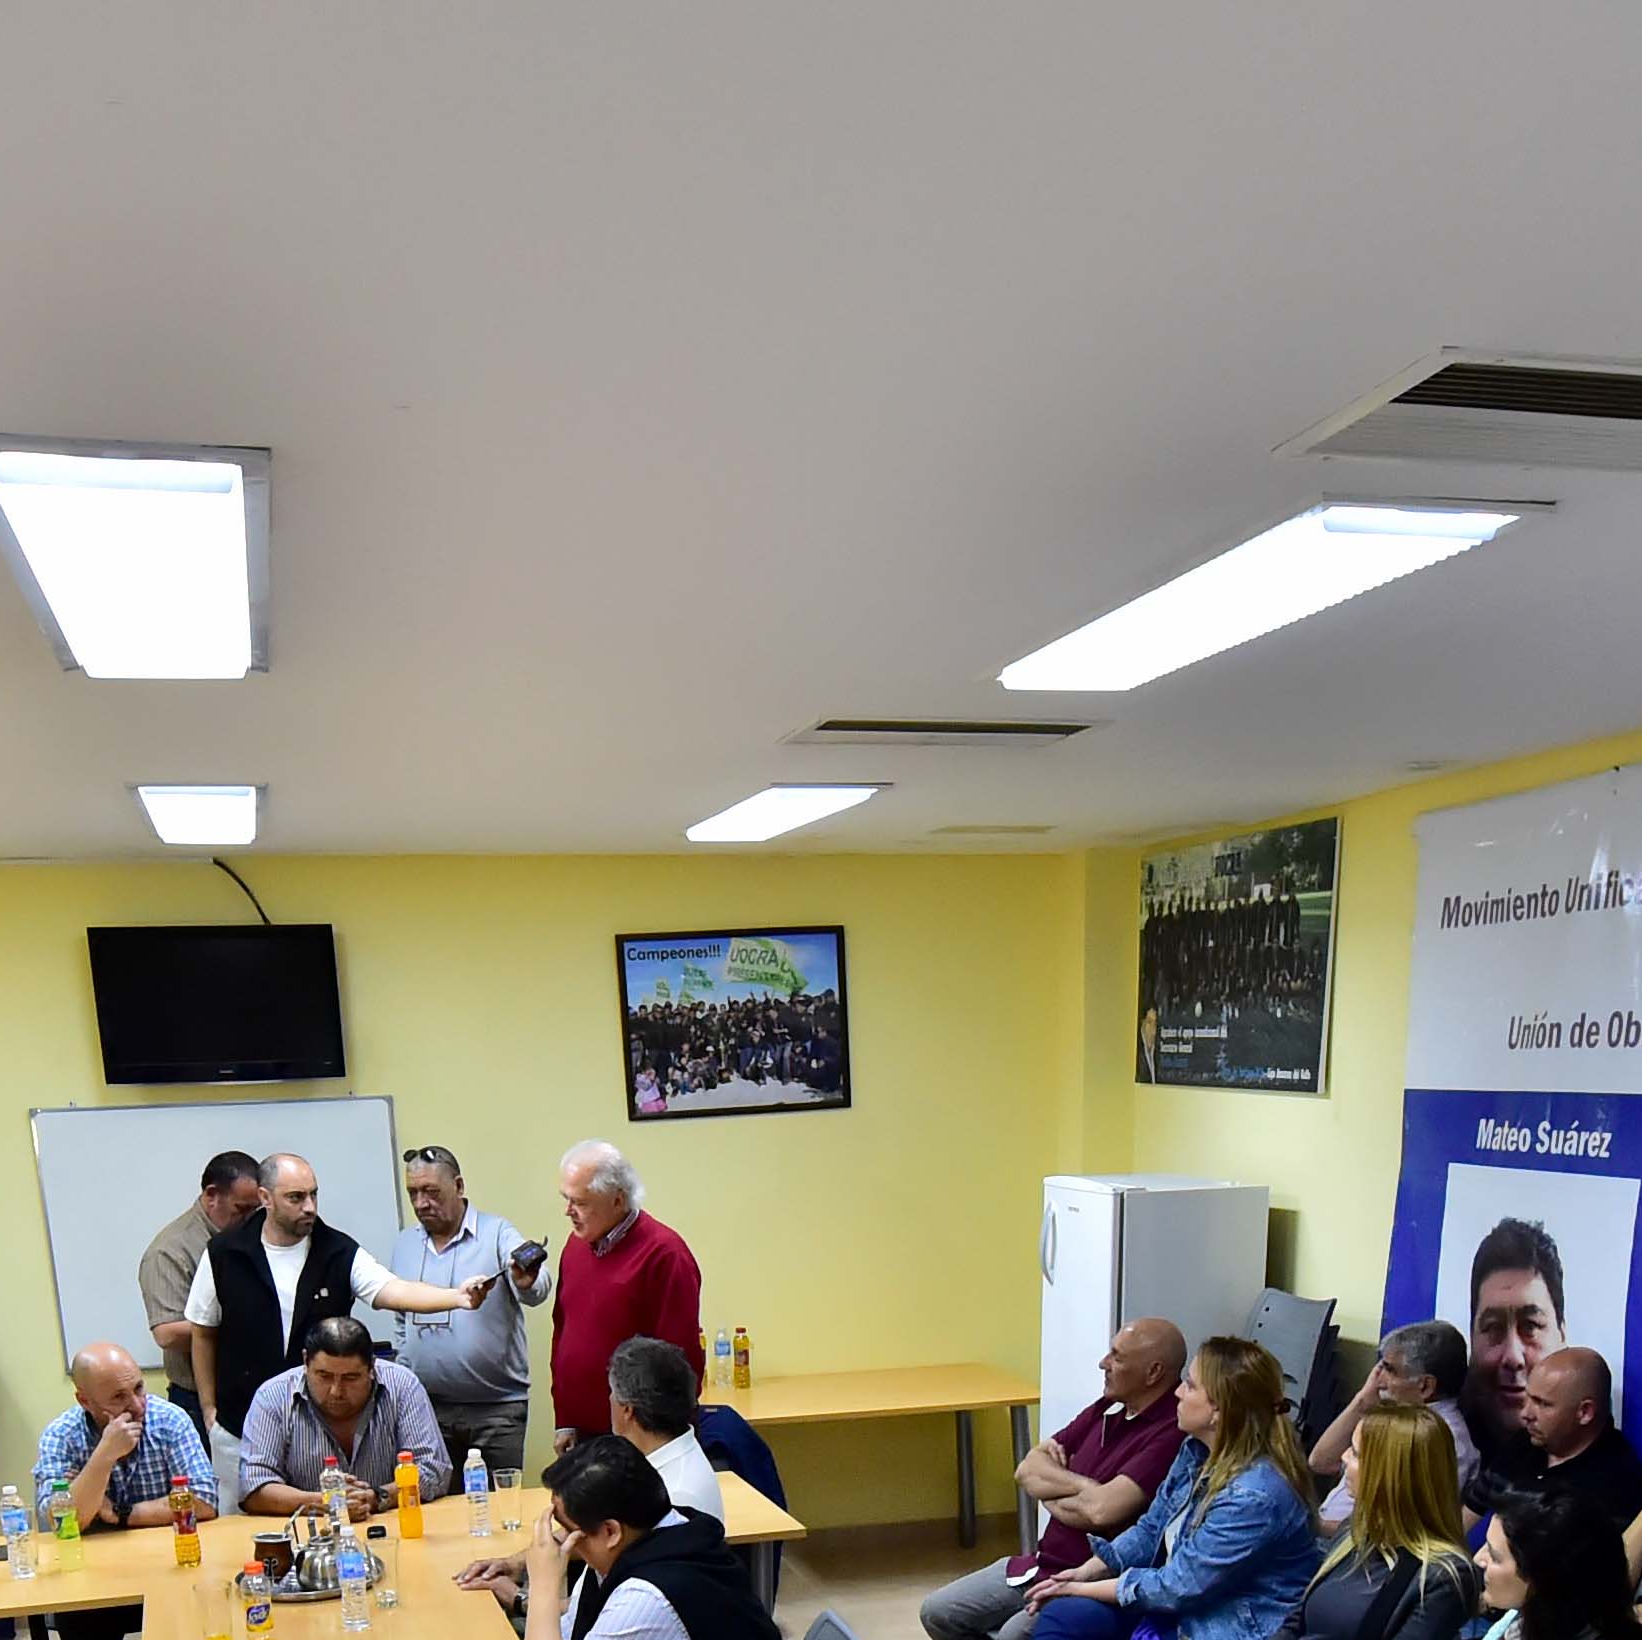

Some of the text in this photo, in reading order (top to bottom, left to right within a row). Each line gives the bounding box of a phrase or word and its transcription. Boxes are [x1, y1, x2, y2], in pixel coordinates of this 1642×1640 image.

[1440, 884, 1561, 930] Movimiento
[627, 944, 721, 962] Campeones!!!
[1507, 1012, 1562, 1051] Unión
[1569, 1014, 1601, 1050] de
[1476, 1116, 1612, 1159] Mateo Suárez
